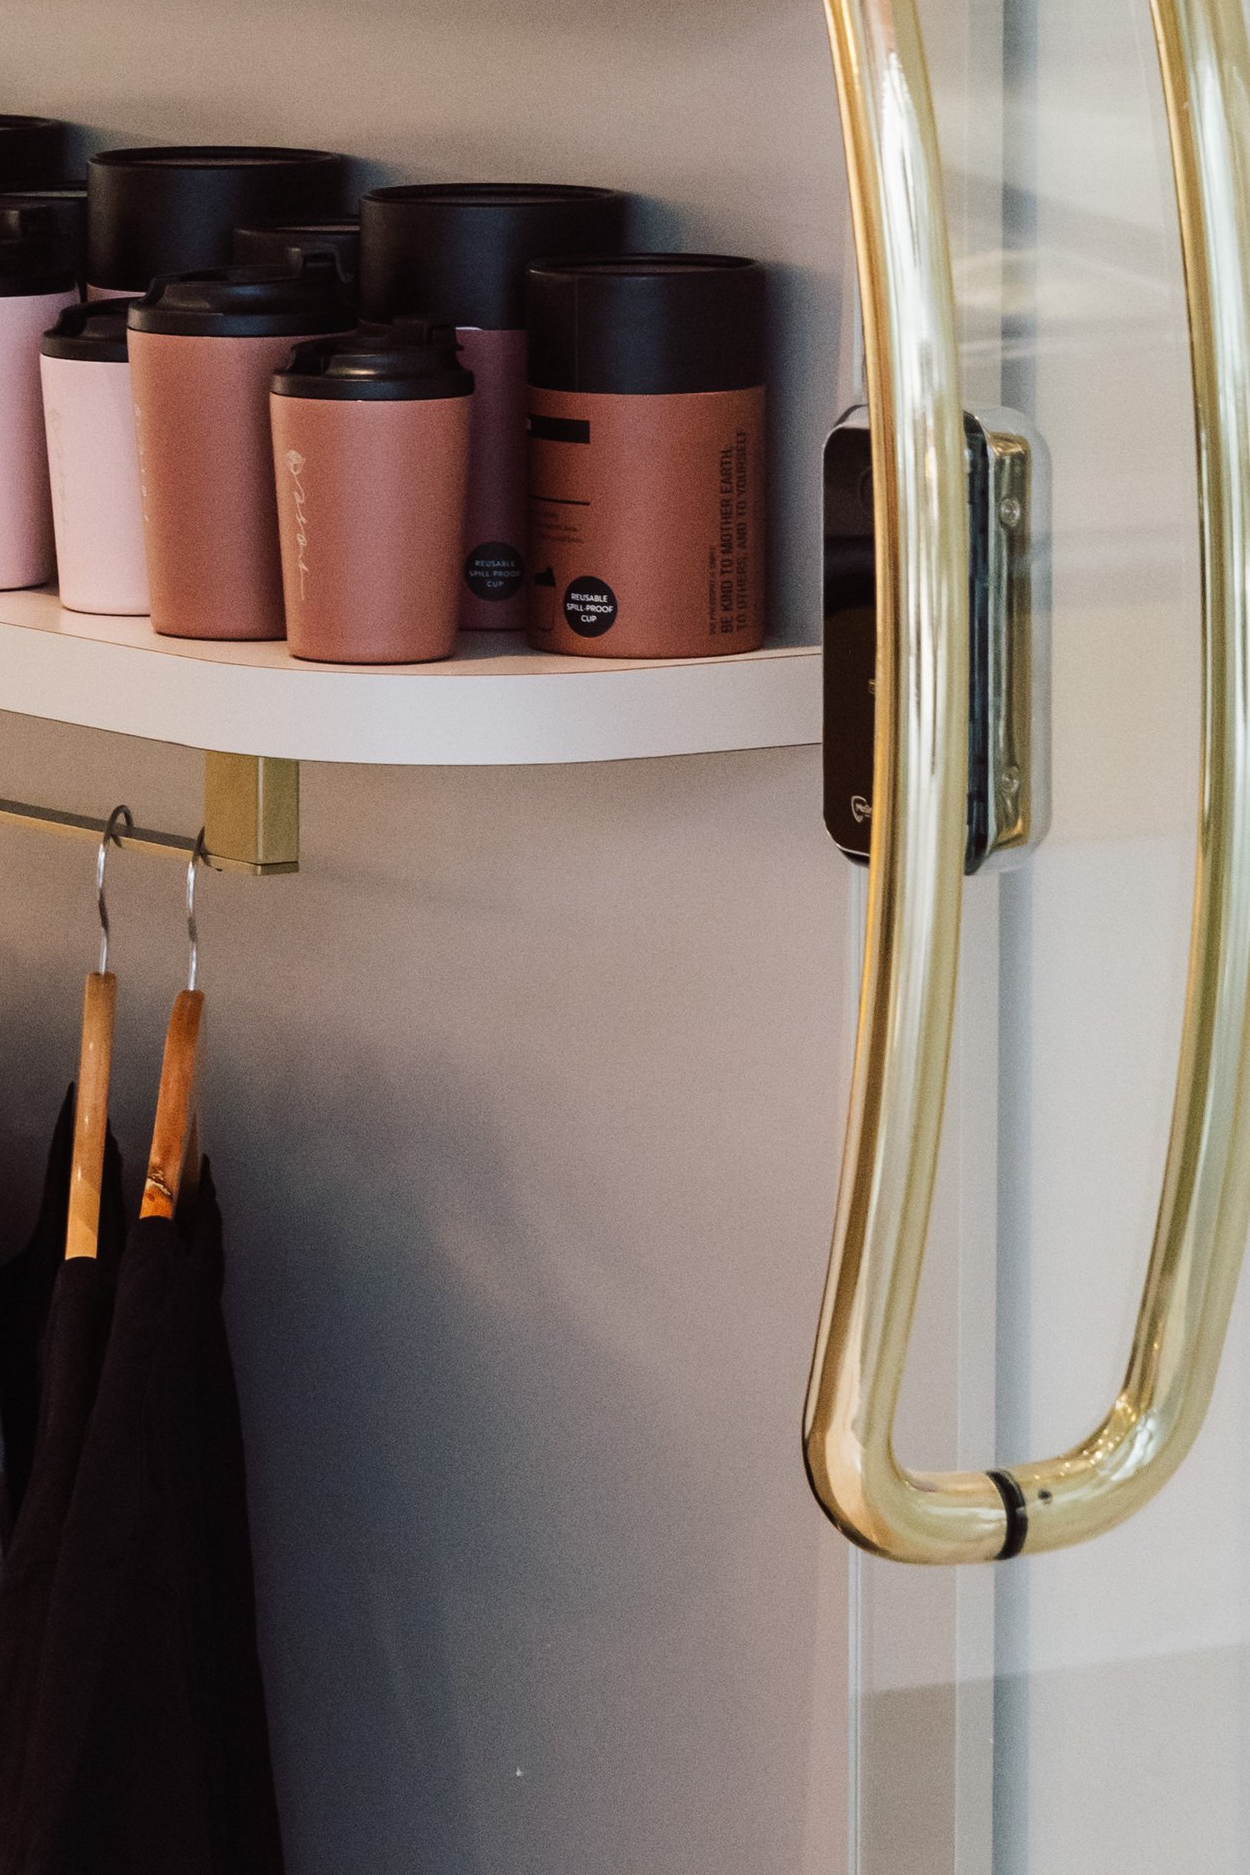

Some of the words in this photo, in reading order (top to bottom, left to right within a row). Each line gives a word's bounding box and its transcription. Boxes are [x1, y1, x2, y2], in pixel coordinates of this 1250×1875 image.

[736, 500, 748, 516] TO
[720, 498, 734, 555] MOTHER
[736, 521, 748, 550] AND
[475, 559, 515, 568] REUSABLE
[720, 558, 734, 576] TO
[486, 580, 504, 588] CUP
[571, 592, 608, 603] REUSABLE
[720, 580, 734, 612] KIND
[566, 603, 614, 614] SPILL-PROOF
[580, 614, 598, 623] CUP
[720, 616, 734, 634] BE
[736, 614, 748, 631] TO
